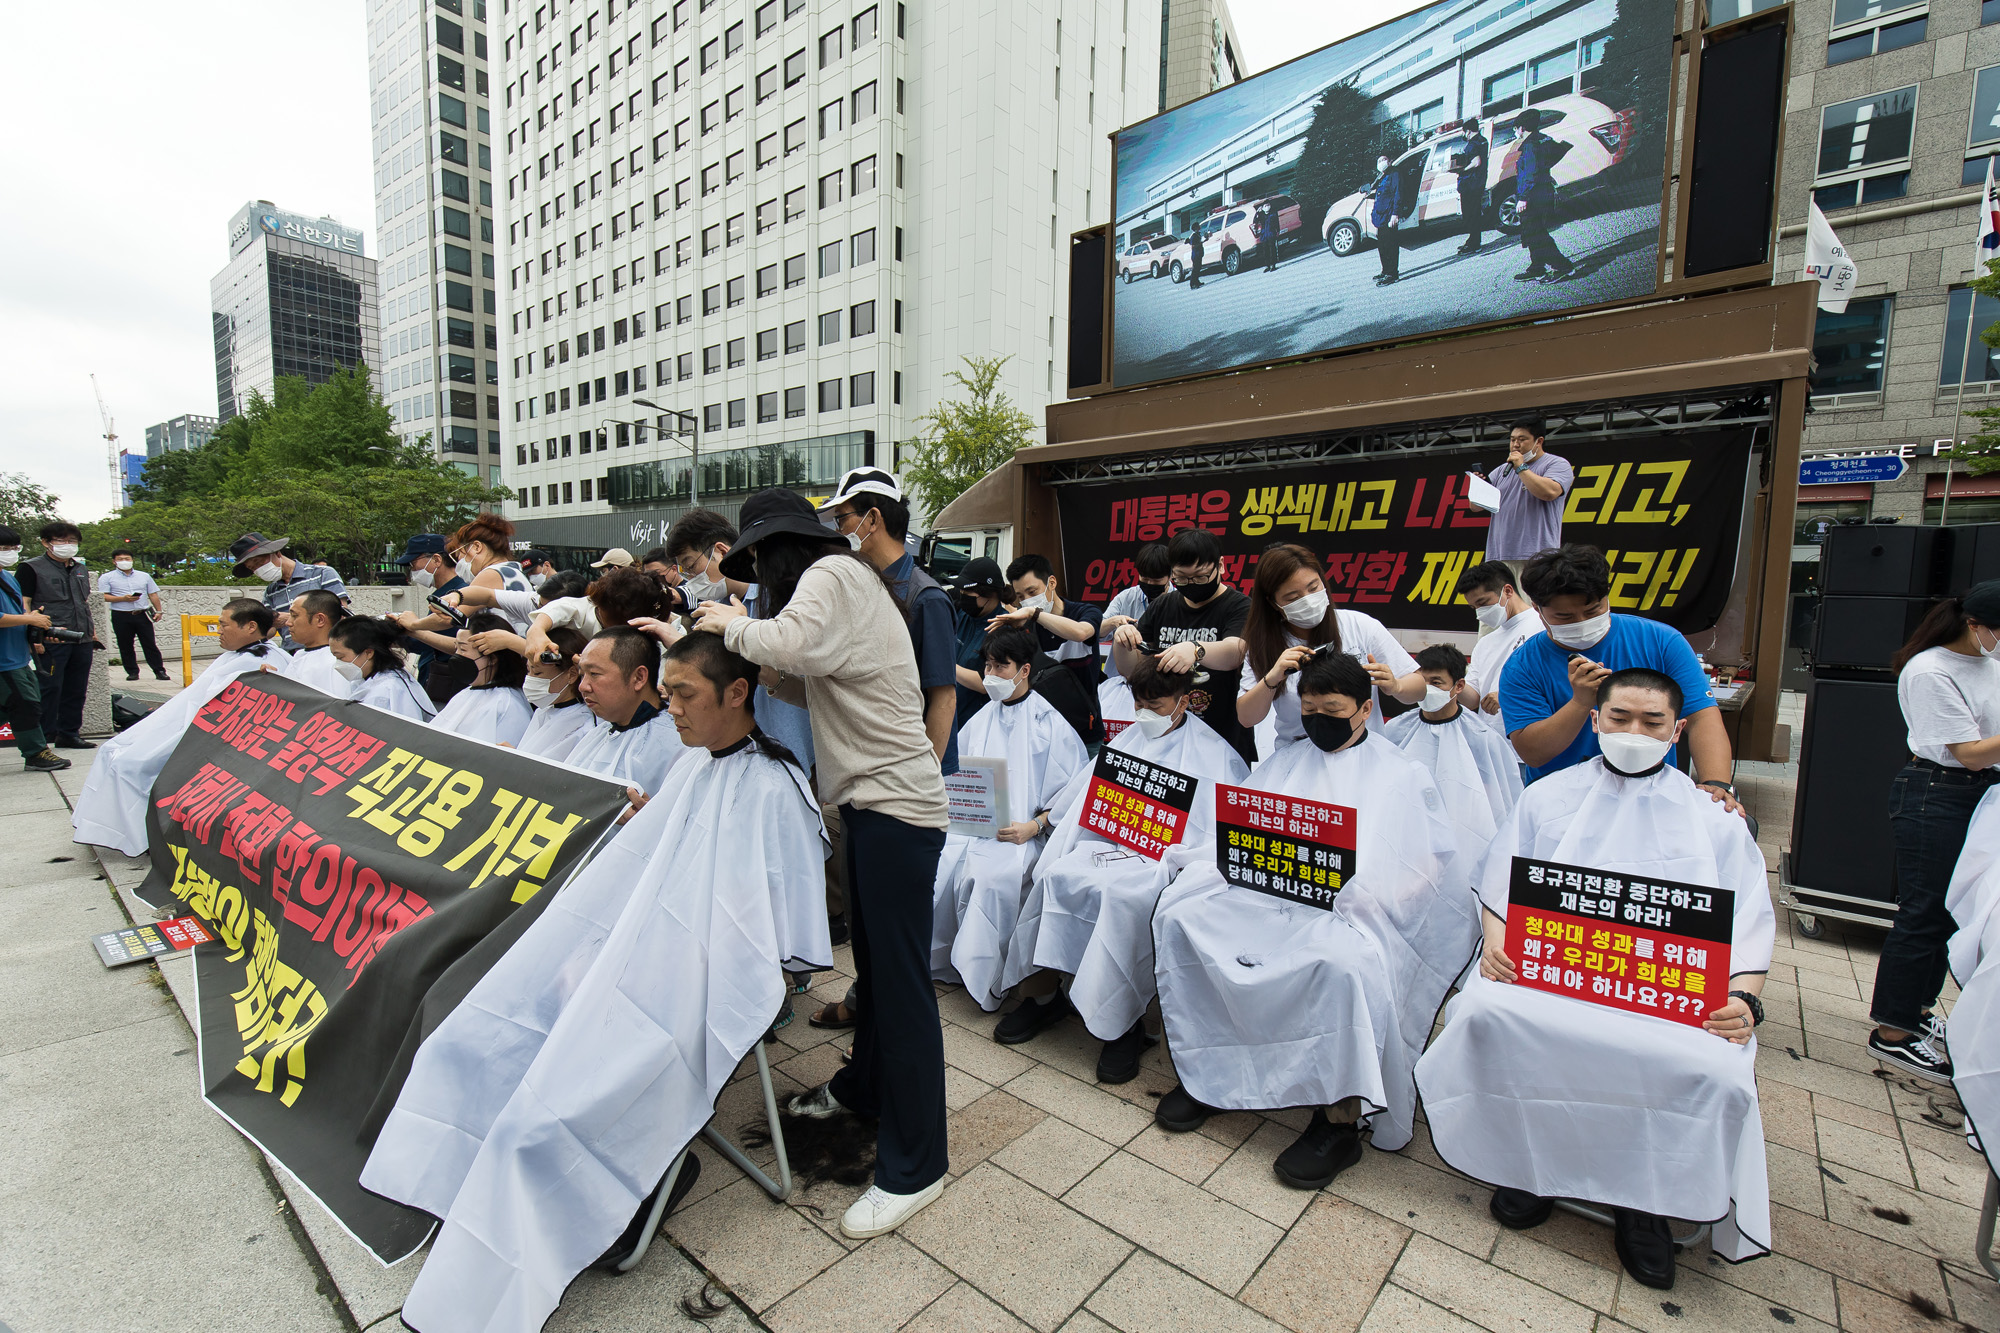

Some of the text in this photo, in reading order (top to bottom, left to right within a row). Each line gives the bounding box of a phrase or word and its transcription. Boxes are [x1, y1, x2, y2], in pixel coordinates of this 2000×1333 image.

[283, 221, 358, 252] 신한카드
[1815, 468, 1883, 476] Cheonggyecheon-ro
[1830, 460, 1868, 469] 청계천로
[1109, 490, 1231, 542] 대통령은
[1240, 480, 1397, 536] 생색내고
[1560, 459, 1691, 527] 리고,
[515, 541, 532, 550] STAGE
[631, 519, 656, 547] Visit
[1159, 626, 1218, 642] SNEAKERS
[267, 711, 387, 796] 일방적
[346, 747, 484, 858] 직고용
[1105, 752, 1187, 792] 정규직전환 중단하고
[1116, 771, 1167, 799] 재논의 하라!
[1088, 812, 1117, 834] 당해야
[1092, 799, 1173, 843] 왜? 우리가 희생을
[1096, 784, 1177, 828] 청와대 성과를 위해
[1227, 790, 1343, 826] 정규직전환 중단하고
[1248, 811, 1319, 838] 재논의 하라!
[220, 791, 294, 885] 전환
[1228, 830, 1342, 870] 청와대 성과를 위해
[1228, 847, 1342, 889] 왜? 우리가 희생을
[1228, 864, 1267, 887] 당해야
[1528, 865, 1712, 913] 정규직전환 중단하고
[1559, 891, 1672, 927] 재논의 하라!
[1525, 915, 1708, 970] 청와대 성과를 위해
[1523, 938, 1706, 995] 왜? 우리가 희생을
[1521, 959, 1706, 1017] 당해야 하나요???
